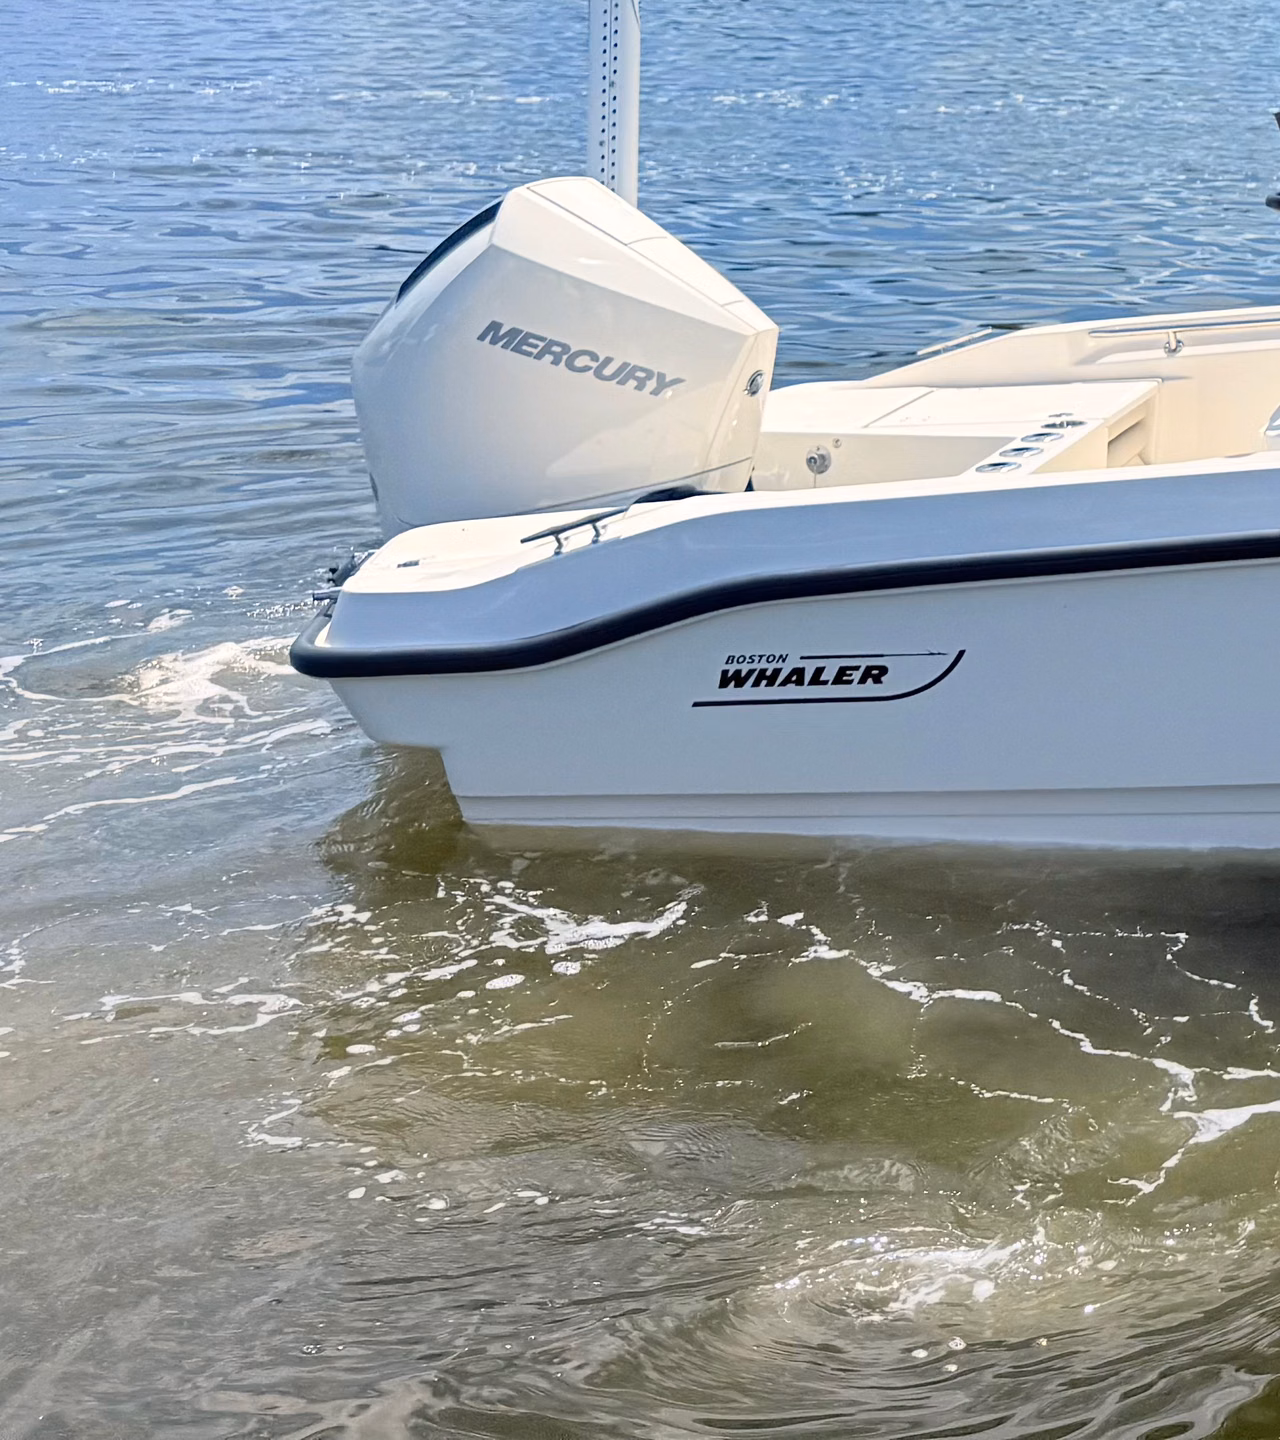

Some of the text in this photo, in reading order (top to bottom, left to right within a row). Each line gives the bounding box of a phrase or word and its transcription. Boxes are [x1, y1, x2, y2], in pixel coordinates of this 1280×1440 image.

[476, 320, 687, 397] MERCURY
[724, 653, 788, 665] BOSTON
[717, 665, 889, 689] WHALER
